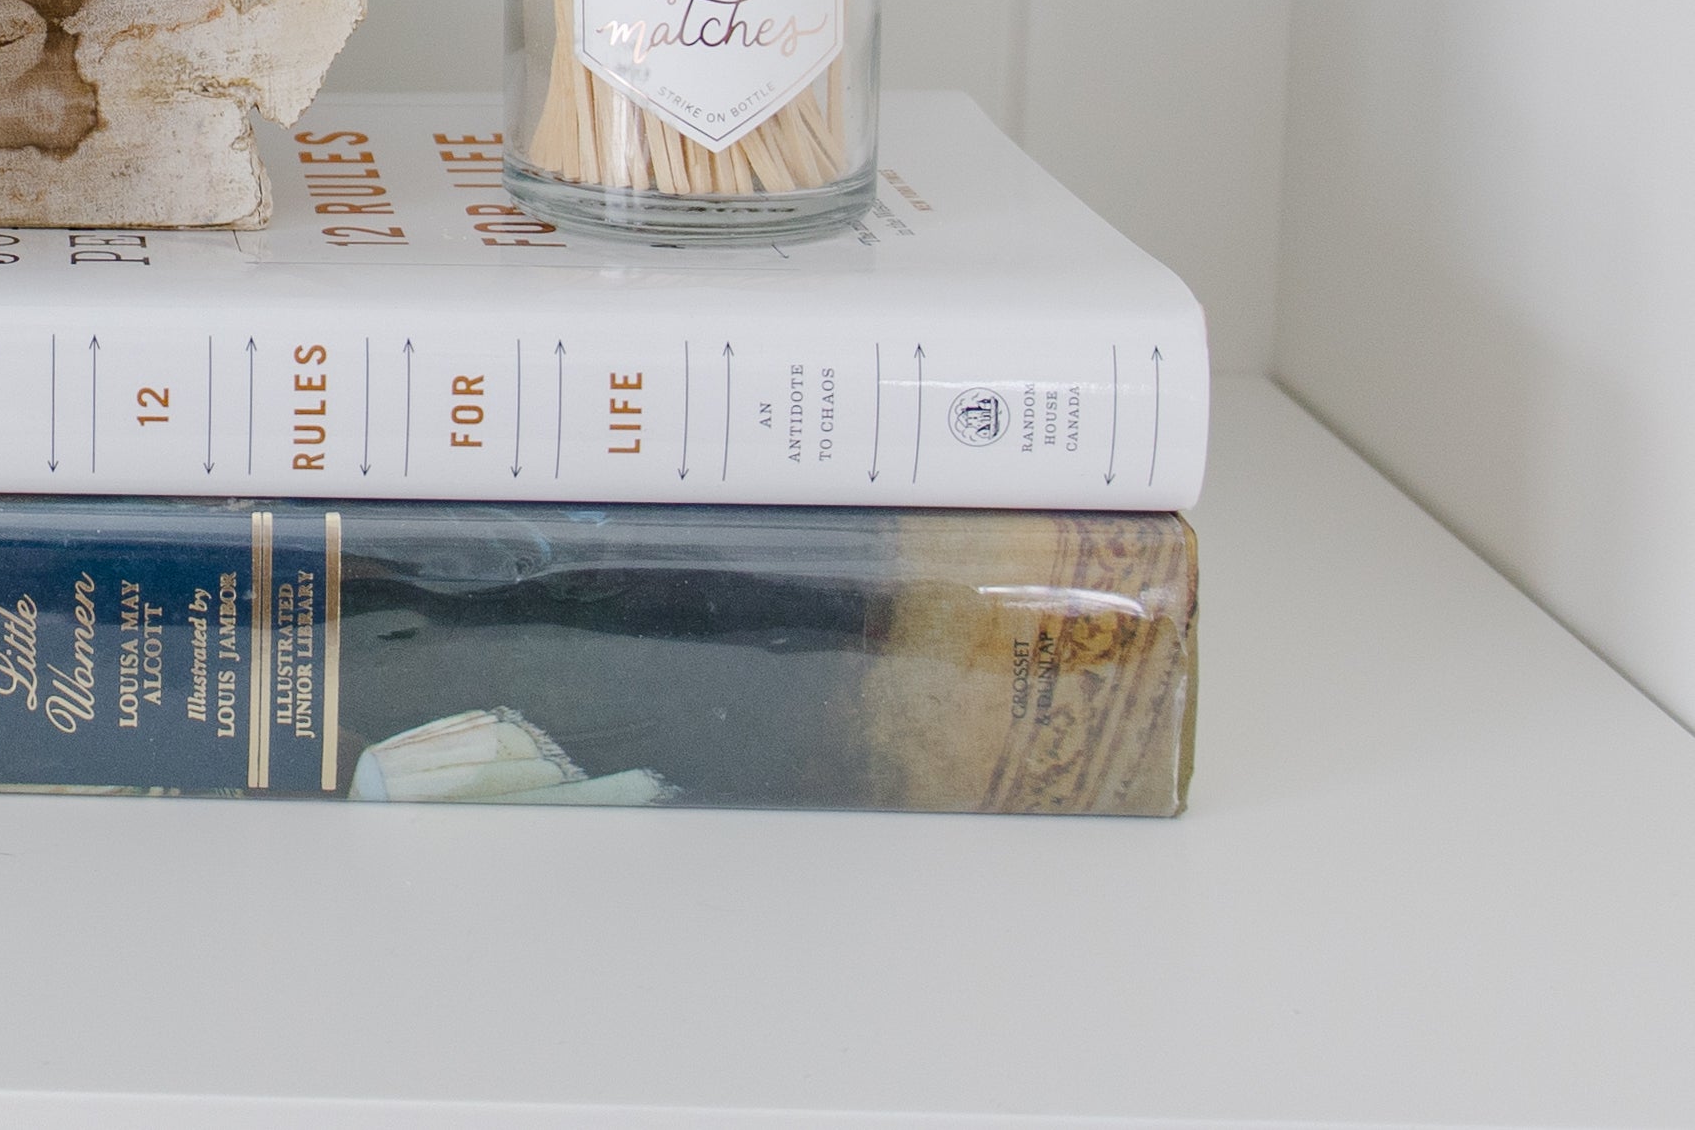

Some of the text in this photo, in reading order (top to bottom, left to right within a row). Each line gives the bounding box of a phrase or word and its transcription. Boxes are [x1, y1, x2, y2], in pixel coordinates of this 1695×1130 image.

[657, 80, 776, 123] STRIKE ON BOTTLE
[294, 131, 409, 247] 12 RULES
[465, 203, 567, 248] FOR
[136, 386, 171, 427] 12
[292, 343, 327, 471] RULES
[450, 374, 485, 449] FOR
[608, 371, 643, 455] LIFE
[758, 401, 772, 429] AN
[788, 364, 804, 463] ANTIDOTE
[819, 367, 836, 462] TO CHAOS
[1022, 383, 1037, 453] RANDOM
[1044, 390, 1059, 446] HOUSE
[1065, 384, 1081, 453] CANADA
[45, 570, 96, 734] Women
[119, 578, 140, 728] LOUISA MAY
[143, 602, 163, 706] ALCOTT
[187, 587, 212, 722] Illustrated by
[217, 571, 241, 738] LOUIS JAMBOR
[276, 582, 295, 725] ILLUSTRATED
[295, 570, 316, 739] JUNIOR LIBRARY
[1012, 639, 1030, 719] GROSSET
[1037, 631, 1055, 708] DUNLAP
